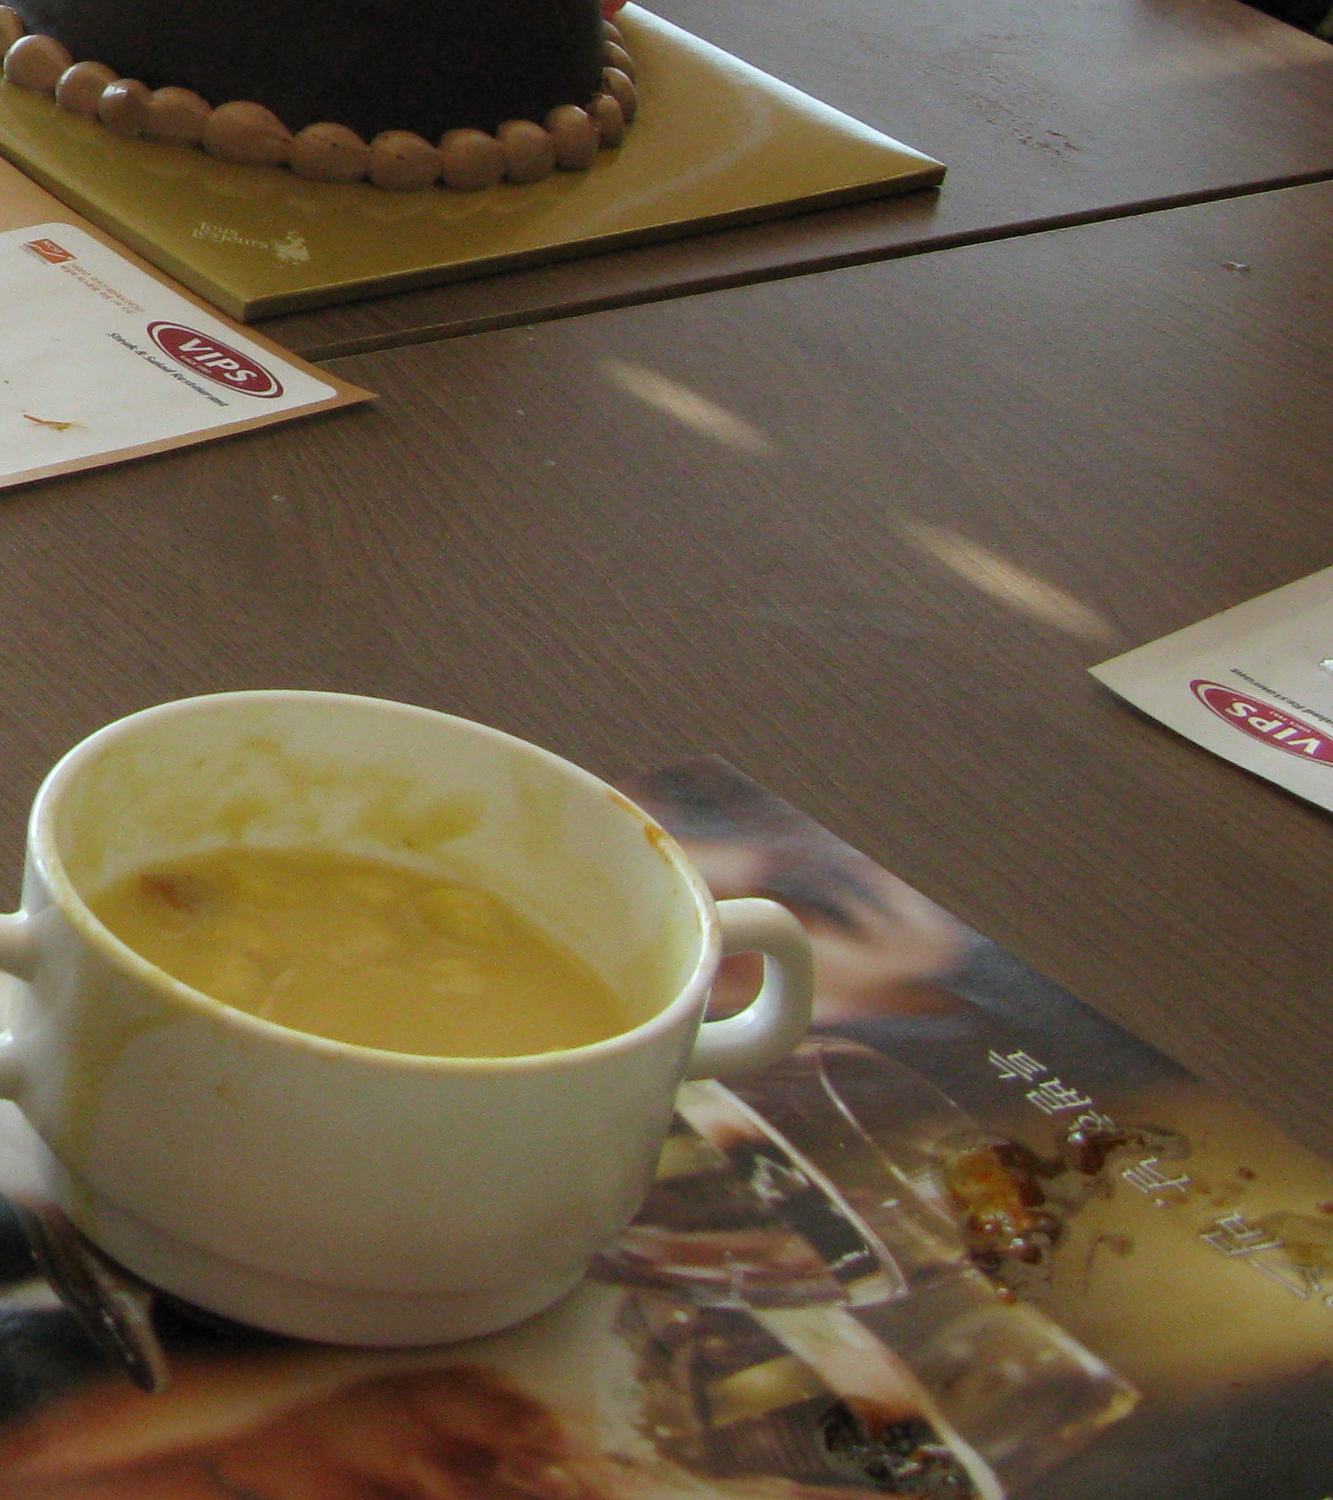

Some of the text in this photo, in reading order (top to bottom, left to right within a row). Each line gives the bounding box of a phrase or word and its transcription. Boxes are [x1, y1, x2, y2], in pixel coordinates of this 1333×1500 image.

[107, 331, 138, 351] Steak
[144, 356, 176, 377] Salad
[170, 371, 229, 408] Restaurant
[178, 338, 258, 383] VIPS
[1224, 701, 1322, 755] VIPS
